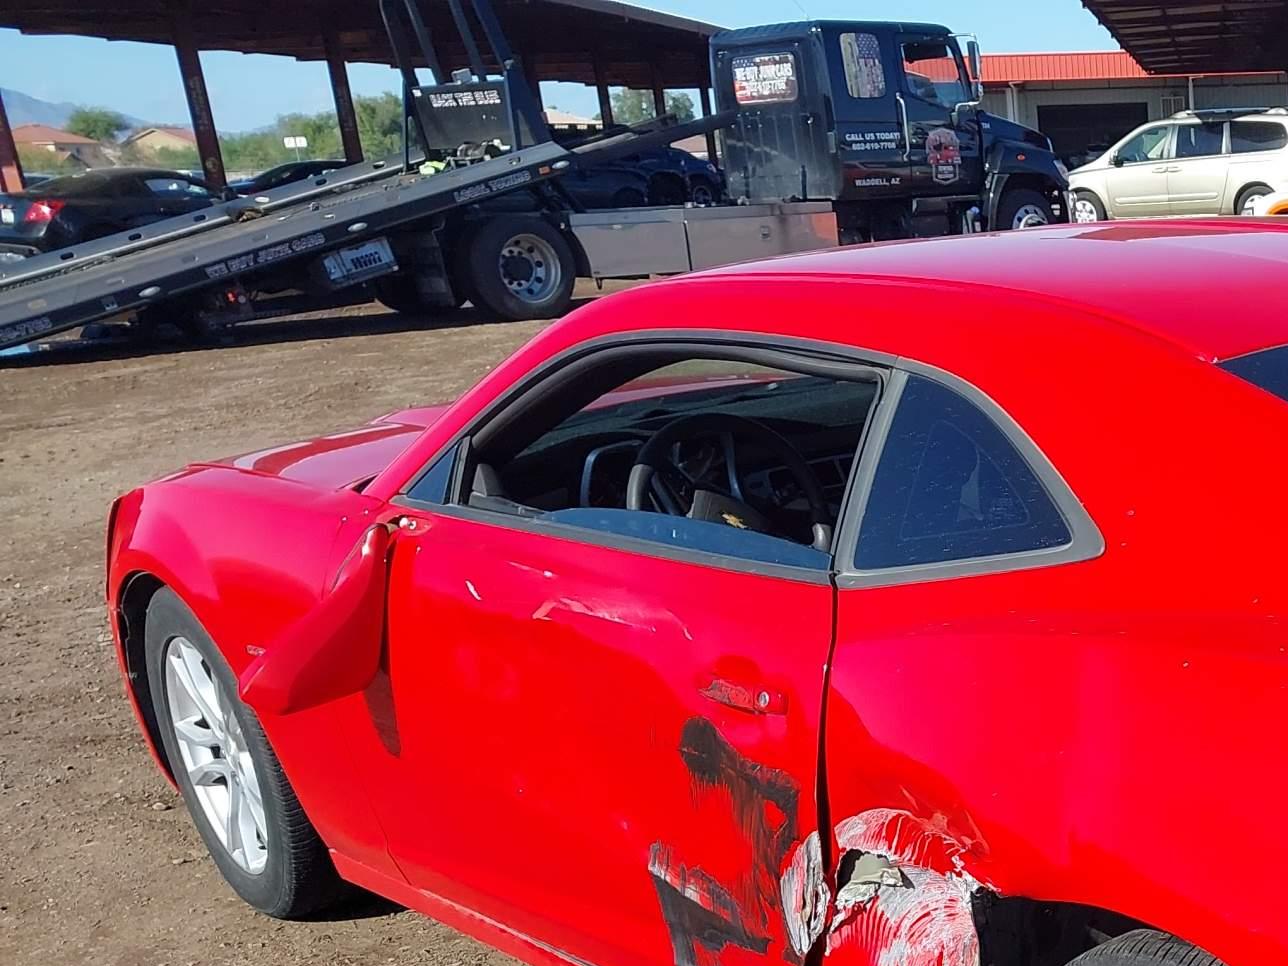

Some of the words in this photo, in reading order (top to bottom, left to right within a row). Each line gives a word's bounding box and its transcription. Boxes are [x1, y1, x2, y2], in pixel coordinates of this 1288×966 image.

[845, 133, 865, 141] CALL
[864, 132, 876, 140] US
[890, 177, 901, 185] AZ
